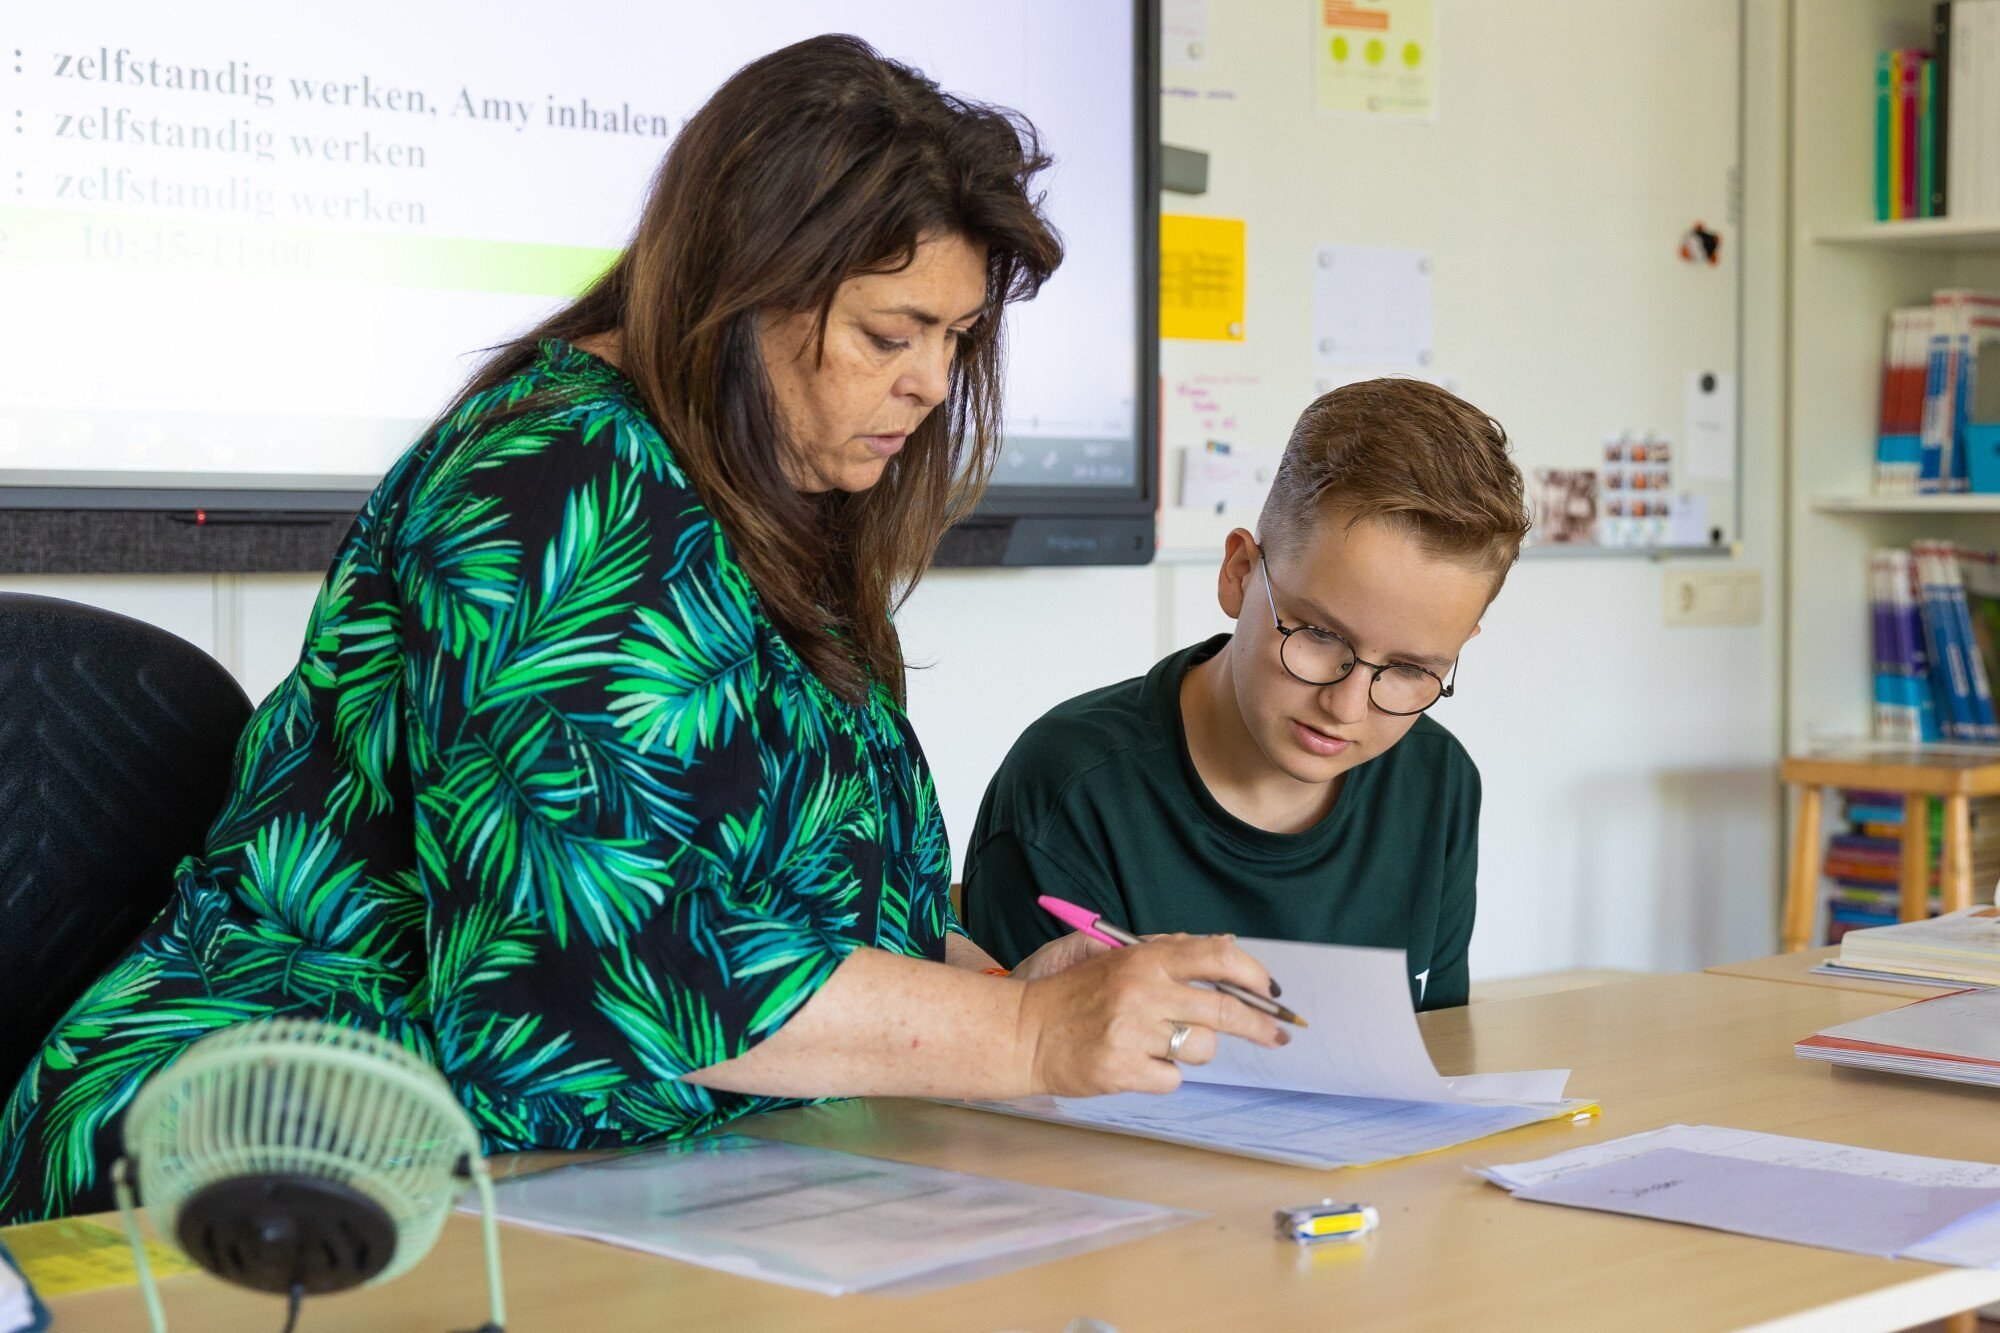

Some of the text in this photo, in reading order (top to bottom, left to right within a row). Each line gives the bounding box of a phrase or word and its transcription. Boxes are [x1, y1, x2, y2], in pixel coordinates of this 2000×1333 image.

[53, 46, 274, 107] zelfstandig
[289, 74, 437, 118] werken,
[452, 86, 533, 133] Amy
[547, 94, 668, 139] inhalen
[54, 106, 275, 162] zelfstandig
[289, 131, 426, 169] werken
[55, 166, 275, 221] zelfstandig
[290, 187, 427, 225] werken
